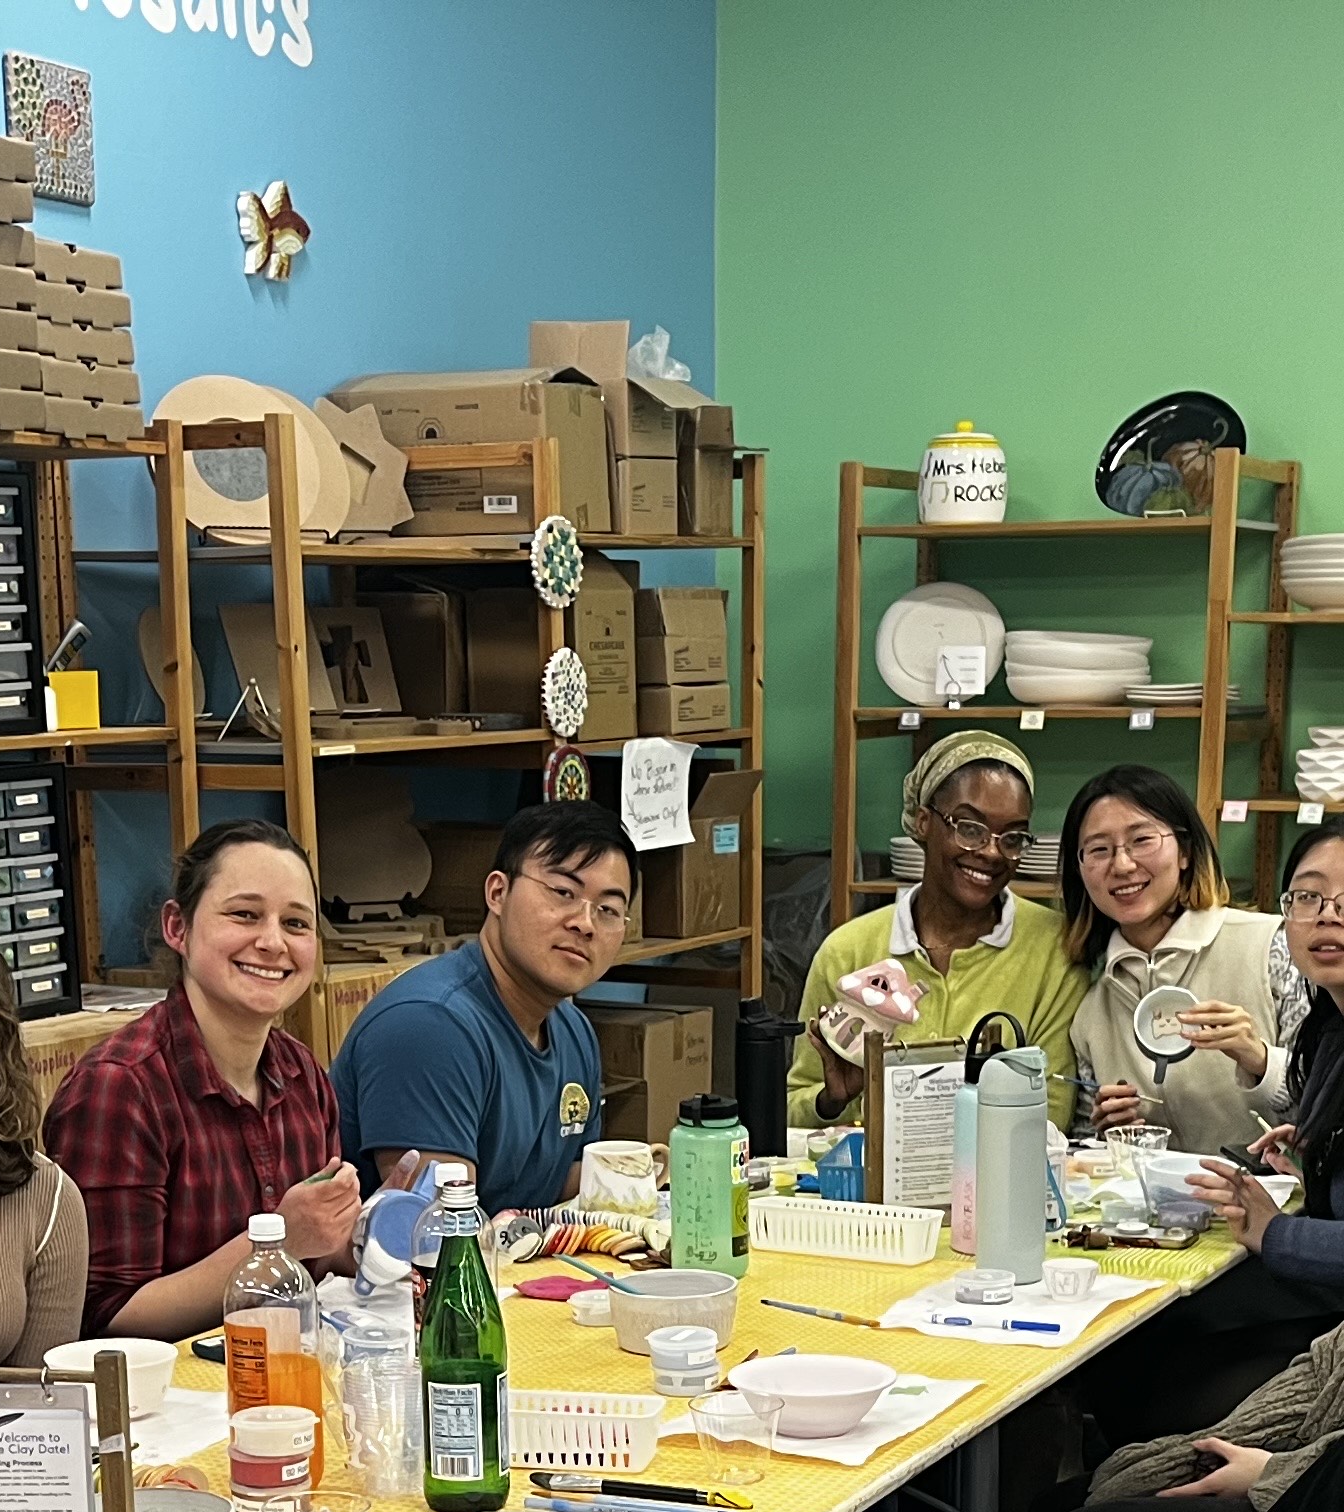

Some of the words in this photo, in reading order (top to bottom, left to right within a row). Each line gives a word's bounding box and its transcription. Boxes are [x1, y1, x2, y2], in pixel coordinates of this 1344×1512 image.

[49, 1432, 61, 1443] to
[8, 1443, 35, 1456] Clay
[38, 1443, 70, 1455] Date!
[12, 1459, 43, 1467] Process
